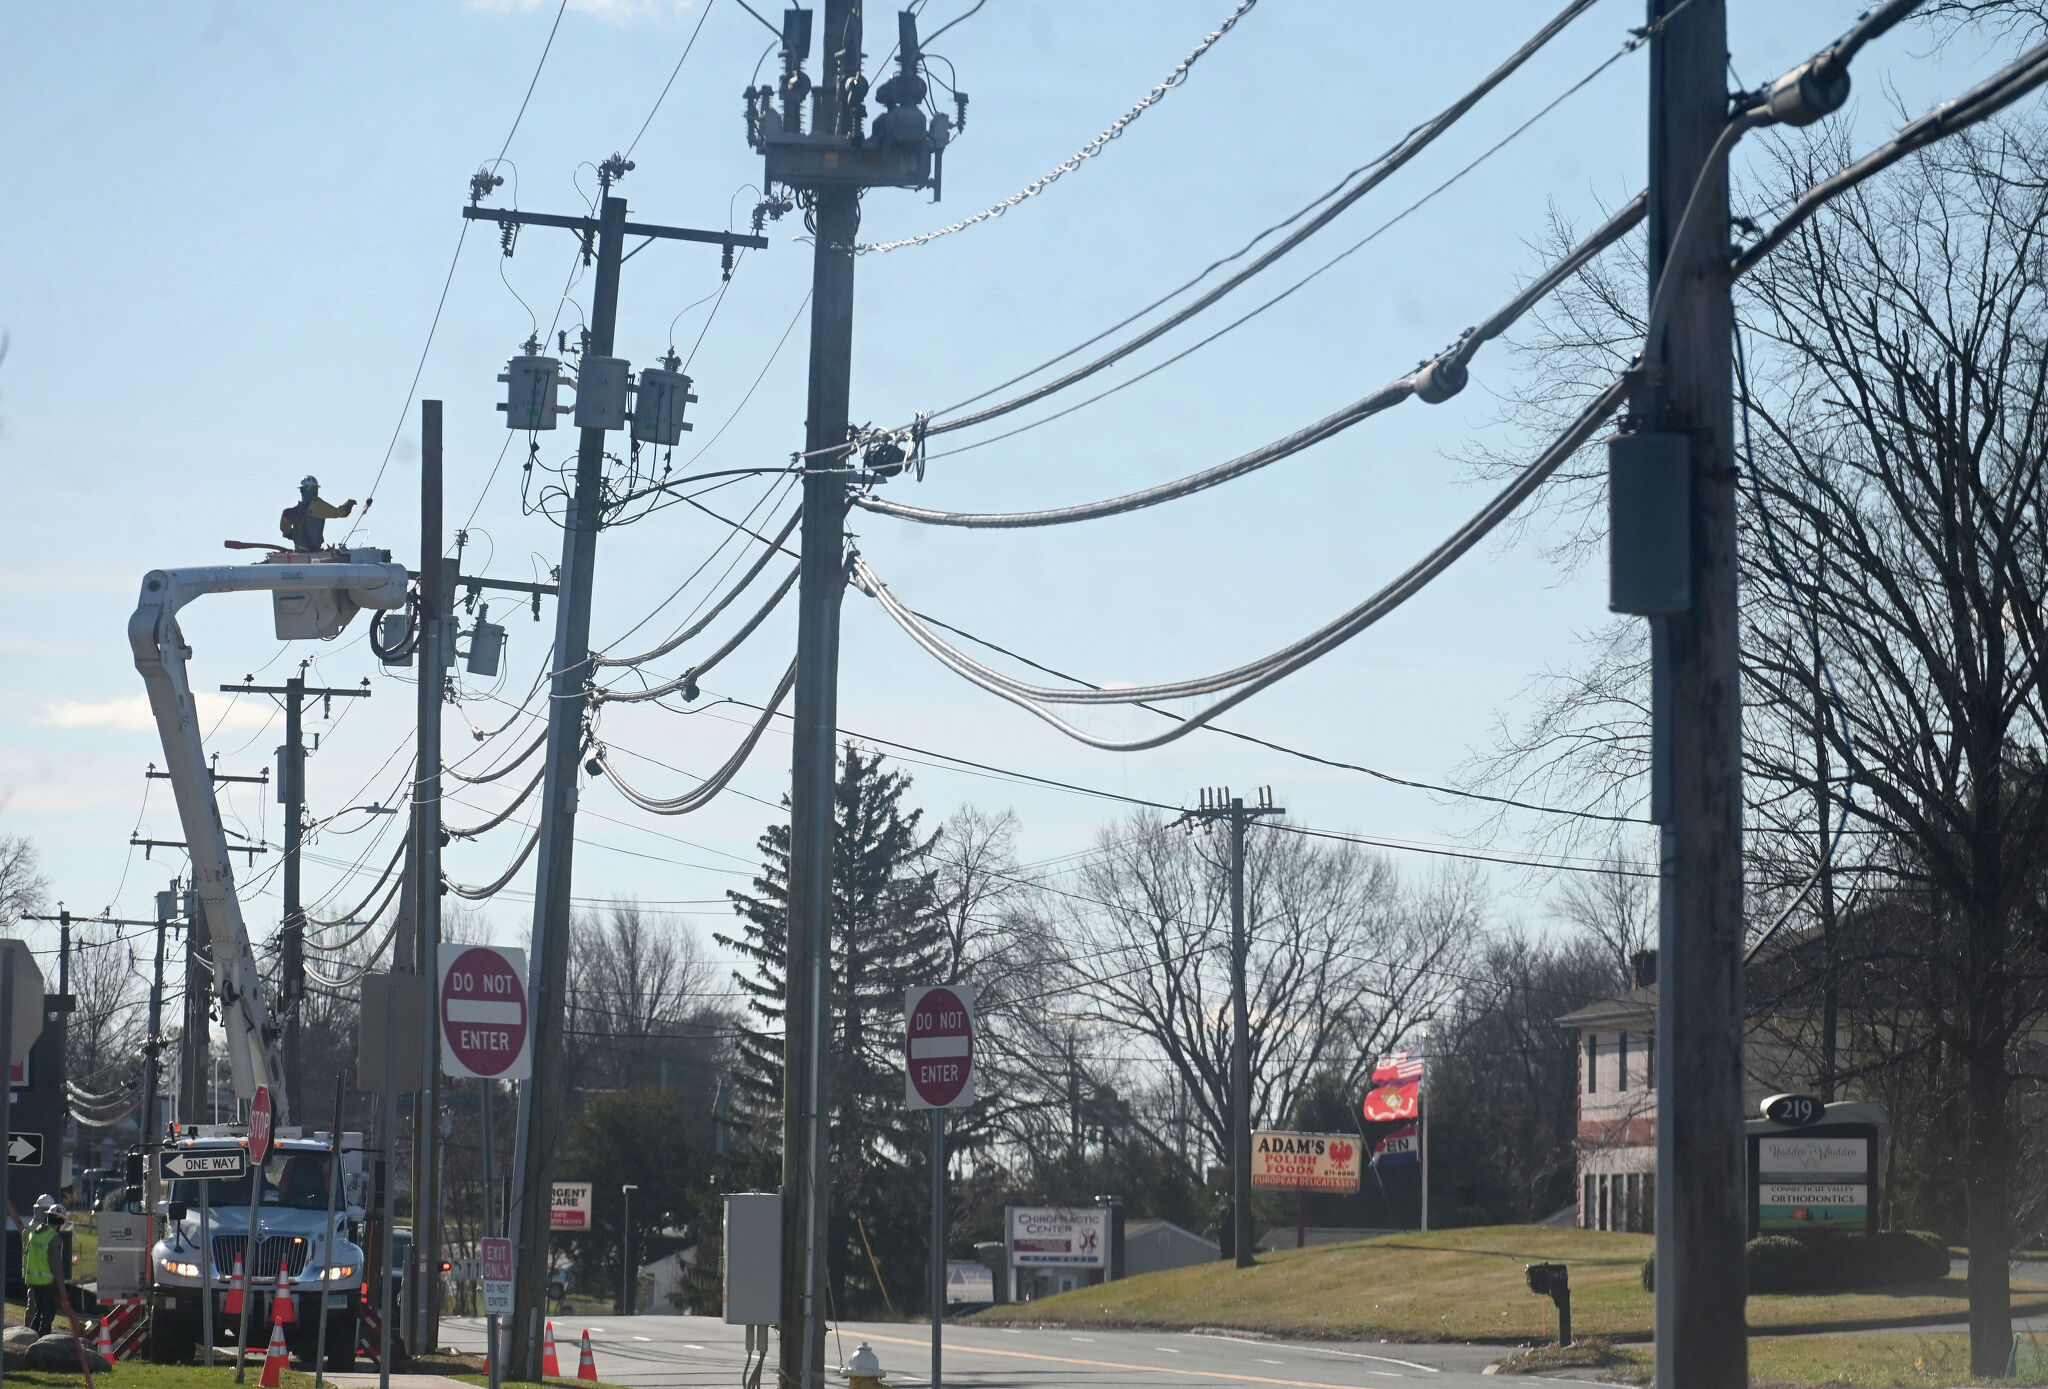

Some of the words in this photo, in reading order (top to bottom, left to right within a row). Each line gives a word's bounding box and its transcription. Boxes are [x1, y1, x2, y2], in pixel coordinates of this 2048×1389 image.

[453, 972, 473, 992] DO
[483, 974, 513, 994] NOT
[916, 1013, 932, 1031] DO
[940, 1011, 963, 1029] NOT
[461, 1030, 510, 1051] ENTER
[921, 1064, 958, 1083] ENTER
[1781, 1100, 1812, 1121] 219
[250, 1112, 270, 1139] STOP
[1258, 1138, 1325, 1155] ADAM'S
[185, 1159, 208, 1170] ONE
[212, 1158, 235, 1169] WAY
[1264, 1154, 1317, 1165] POLISH
[1266, 1164, 1315, 1175] FOODS
[1255, 1176, 1298, 1187] EUROPEAN
[1771, 1194, 1855, 1203] ORTHODONTICS
[487, 1246, 507, 1261] EXIT
[485, 1263, 510, 1279] ONLY
[486, 1284, 496, 1293] DO
[498, 1284, 509, 1294] NOT
[489, 1297, 508, 1307] ENTER
